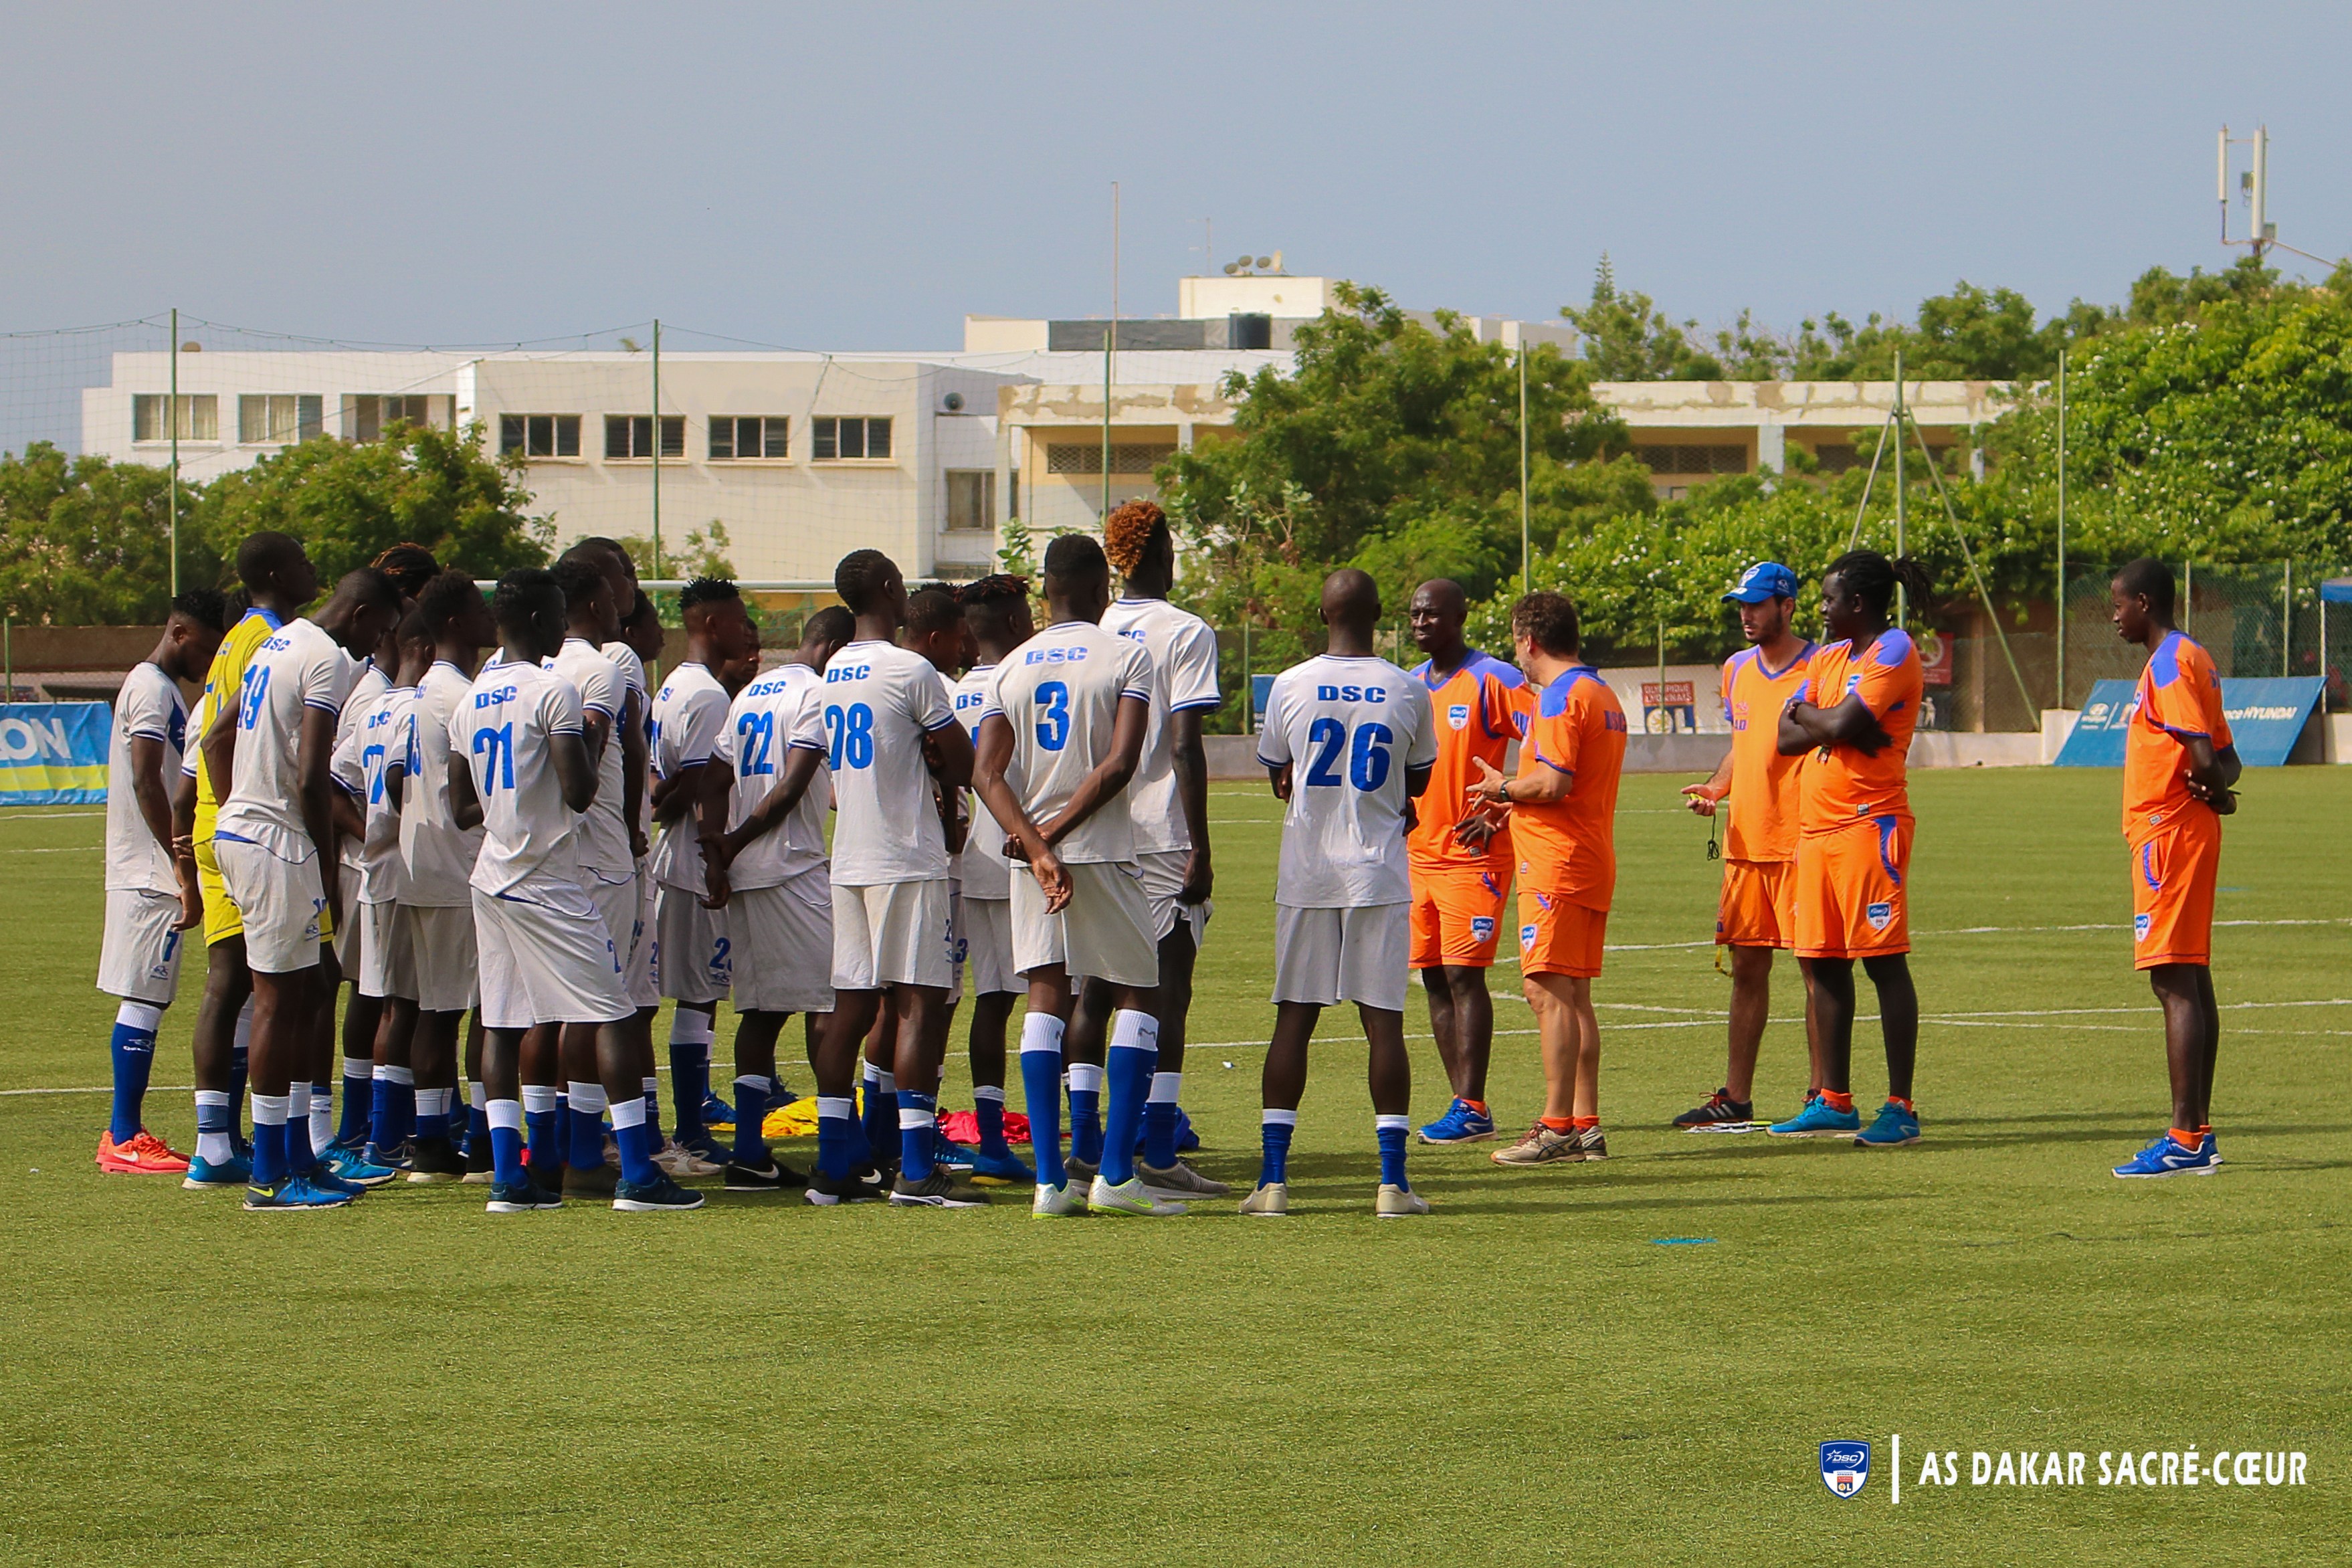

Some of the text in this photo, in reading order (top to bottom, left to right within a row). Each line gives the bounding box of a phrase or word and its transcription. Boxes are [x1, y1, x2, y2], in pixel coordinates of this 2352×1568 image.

[261, 636, 291, 651] DSC
[1025, 646, 1088, 665] DSC
[827, 664, 870, 683] DSC
[237, 664, 270, 729] 19
[476, 686, 517, 709] DSC
[748, 681, 786, 697] DSC
[1318, 686, 1386, 703] DSC
[957, 692, 983, 710] DS
[1035, 681, 1070, 751] 3
[0, 718, 72, 760] ON
[739, 710, 773, 777] 22
[825, 703, 874, 771] 28
[1306, 718, 1393, 791] 26
